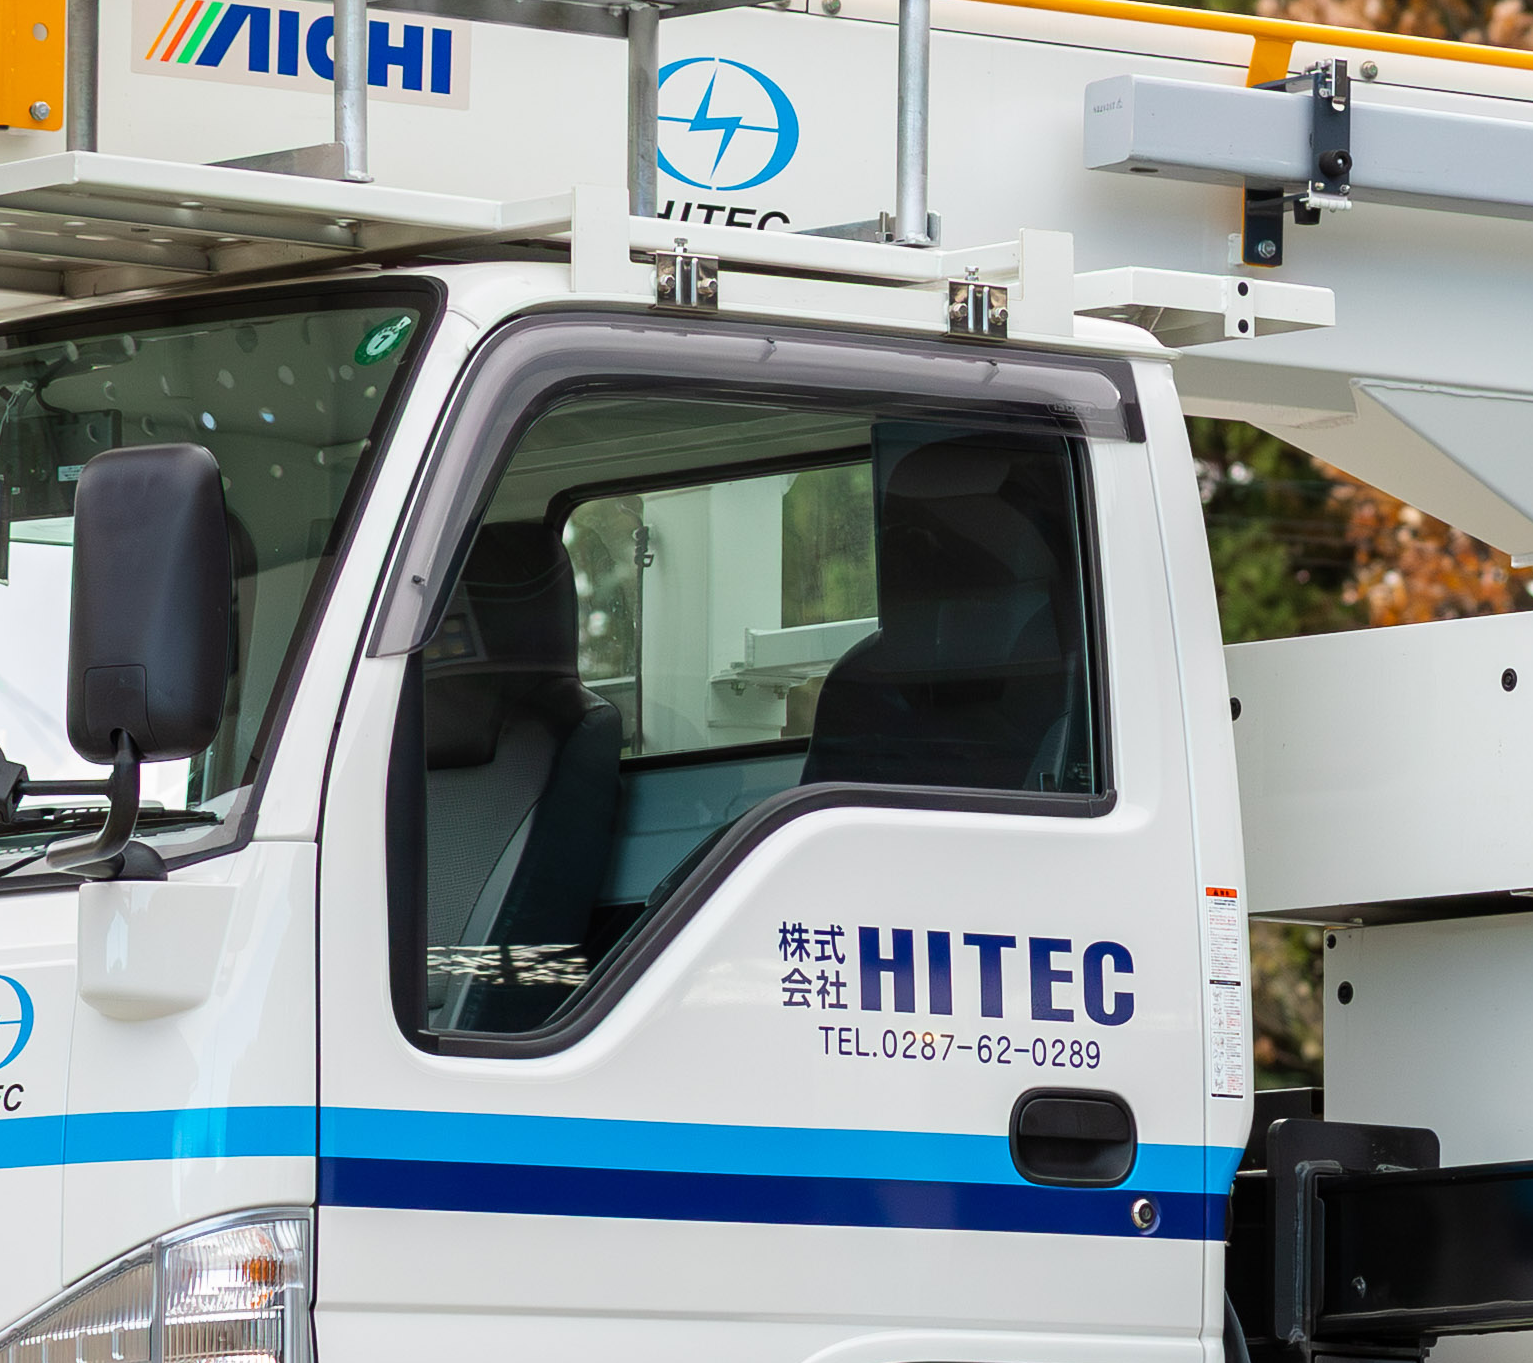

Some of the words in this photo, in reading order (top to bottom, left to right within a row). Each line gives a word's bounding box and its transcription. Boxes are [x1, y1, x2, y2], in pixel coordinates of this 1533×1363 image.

[195, 3, 452, 95] AICHI
[778, 921, 846, 965] 株式
[858, 926, 1135, 1027] HITEC
[781, 967, 848, 1010] 会社
